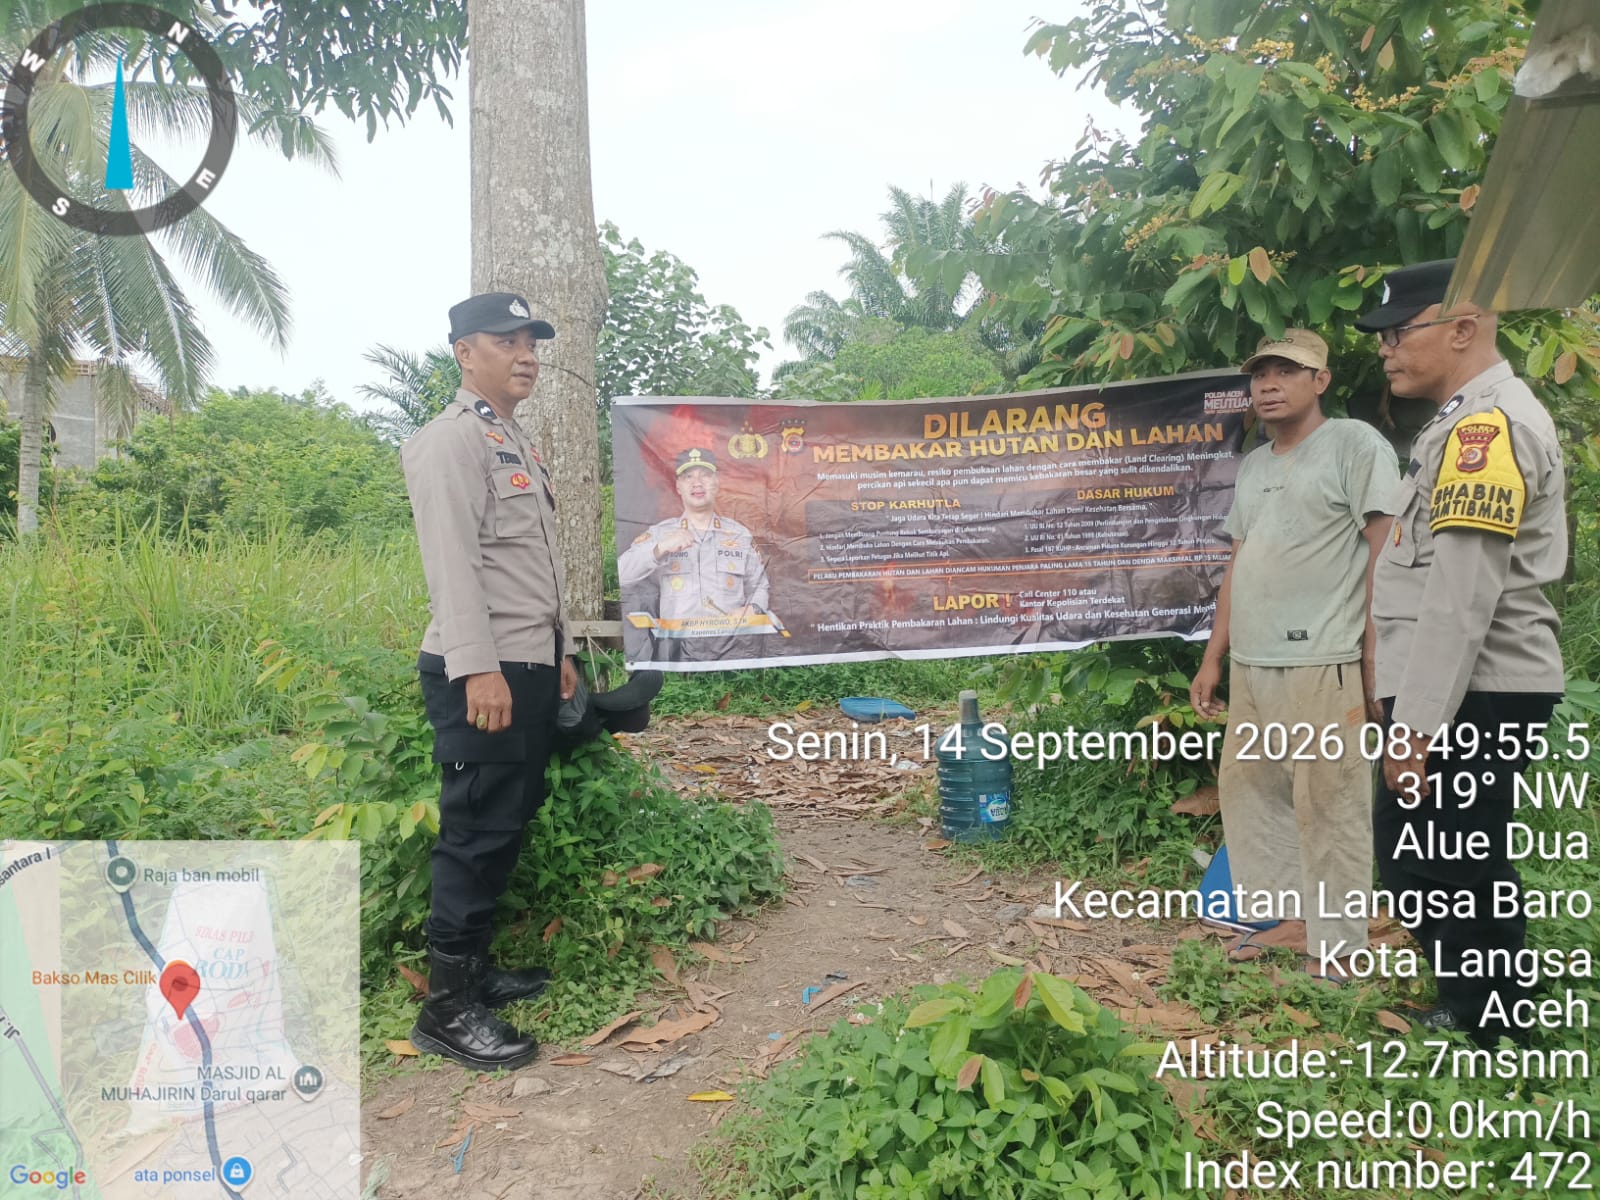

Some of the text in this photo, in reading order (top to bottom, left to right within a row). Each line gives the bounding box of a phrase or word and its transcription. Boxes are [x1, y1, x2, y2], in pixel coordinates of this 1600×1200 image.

[924, 402, 1107, 440] DILARANG
[813, 422, 1224, 463] MEMBAKAR HUTAN DAN LAHAN
[817, 450, 1234, 481] Memasuki musim kemarau, resiko pembukaan lahan dengan cara membakar (Land Clearing) Meningkat,
[857, 463, 1193, 491] percikan api sekecil apa pun dapat memicu kebakaran besar yang sulit dikendalikan.
[1077, 485, 1175, 501] DASAR HUKUM
[1434, 483, 1512, 506] BHABIN
[851, 498, 961, 512] STOP KARHUTLA
[718, 550, 743, 558] POLRI
[883, 569, 905, 577] HUTAN
[906, 568, 920, 576] DAN
[921, 567, 944, 576] LAHAN
[945, 566, 977, 575] DIANCAM
[1040, 561, 1063, 570] PALING
[1064, 560, 1083, 569] LAMA
[1093, 559, 1116, 568] TAHUN
[1117, 558, 1131, 567] DAN
[1132, 557, 1156, 566] DENDA
[933, 593, 999, 611] LAPOR
[1019, 587, 1097, 599] Call Center 110 atau
[1020, 595, 1125, 609] Kantor Kepolisian Terdekat
[817, 621, 857, 632] Hentikan
[860, 619, 890, 631] Praktik
[891, 617, 945, 630] Pembakaran
[947, 616, 973, 627] Lahan
[980, 614, 1019, 626] Lindungi
[1020, 611, 1054, 622] Kualitas
[1055, 610, 1083, 621] Udara
[1085, 609, 1102, 620] dan
[1104, 607, 1150, 618] Kesehatan
[1152, 606, 1191, 616] Generasi
